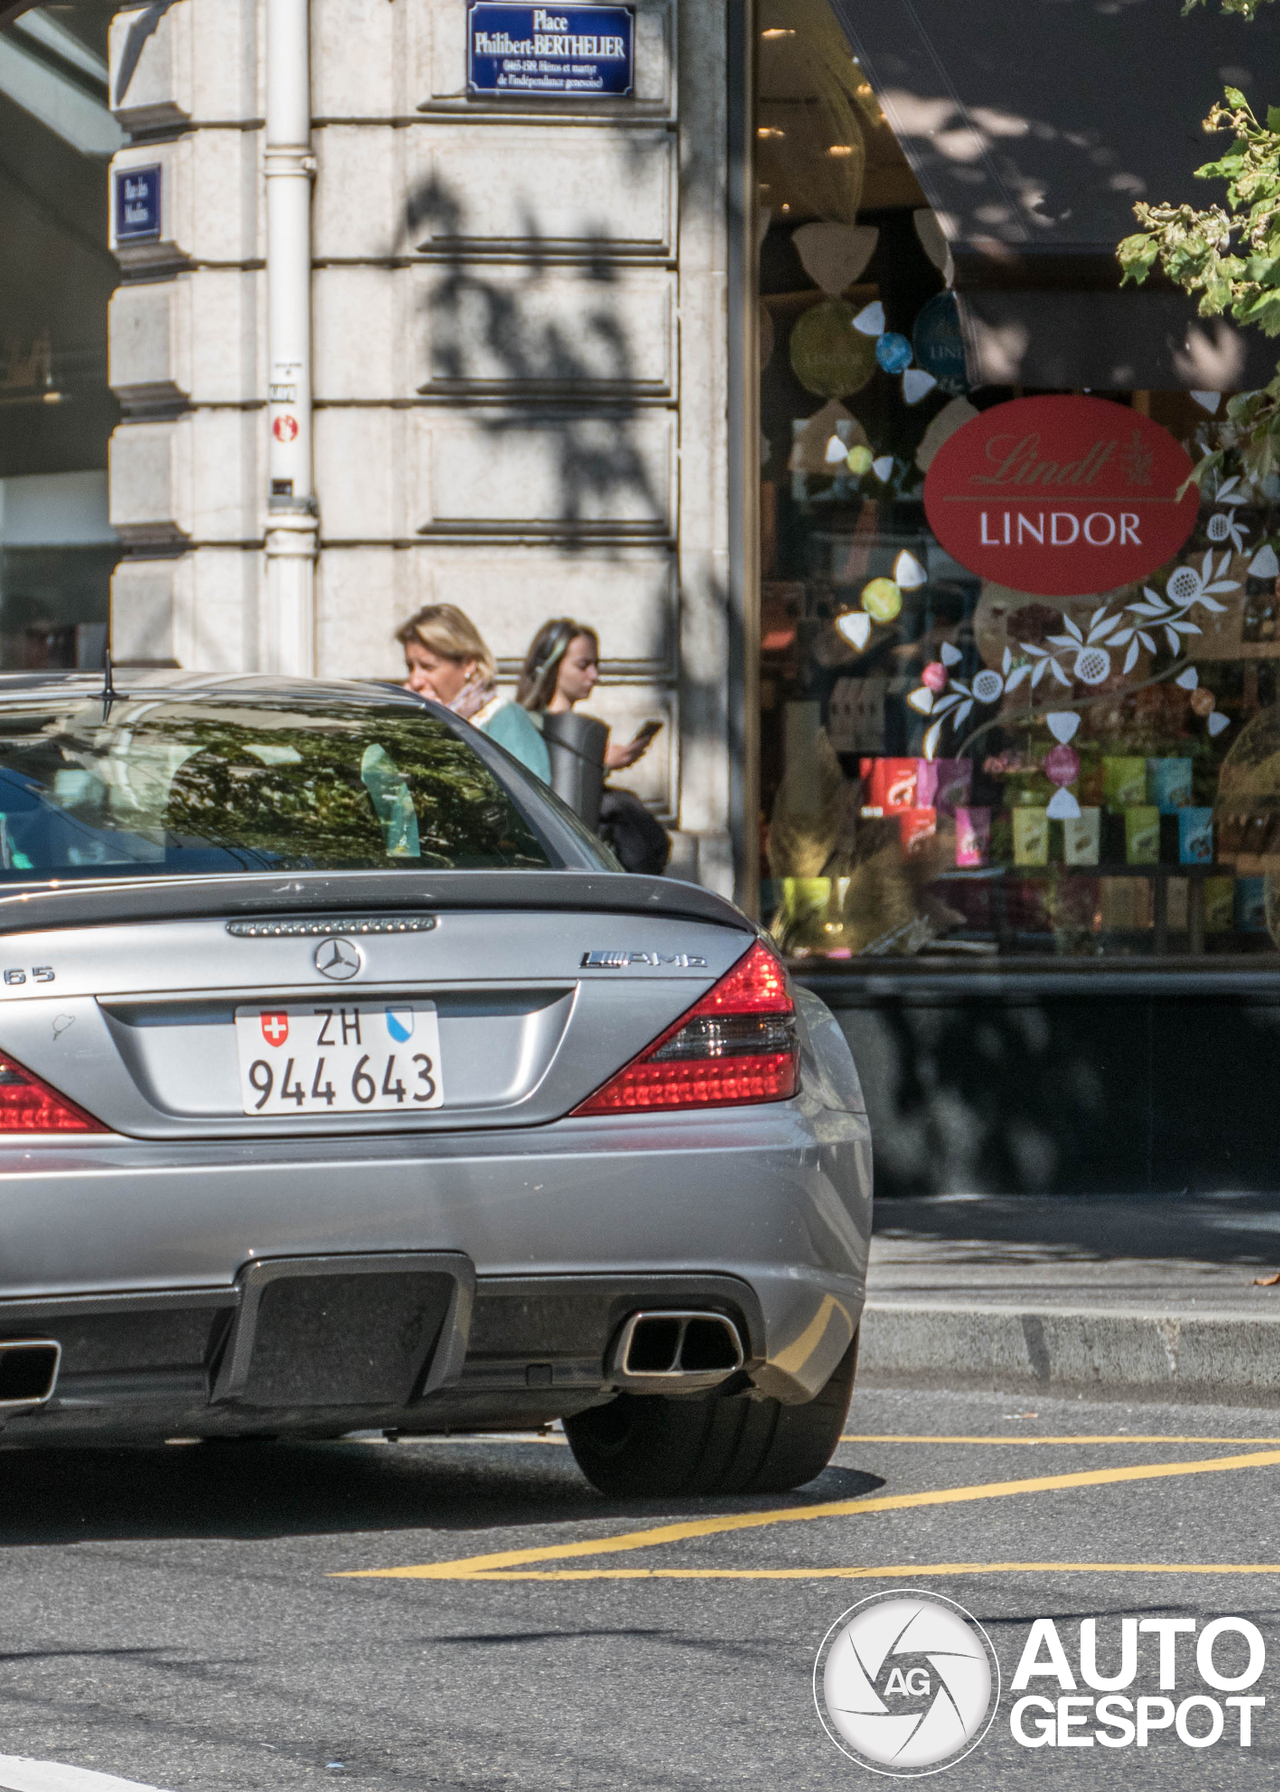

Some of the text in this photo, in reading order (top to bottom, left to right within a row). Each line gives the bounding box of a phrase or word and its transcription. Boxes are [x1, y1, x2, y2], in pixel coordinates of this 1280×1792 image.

[533, 9, 568, 31] Place
[474, 32, 626, 58] Philibert-BERTHELIER
[970, 432, 1117, 486] Lindt
[980, 512, 1142, 545] LINDOR
[3, 966, 56, 985] 65
[314, 1008, 362, 1046] ZH
[249, 1053, 436, 1110] 944 643
